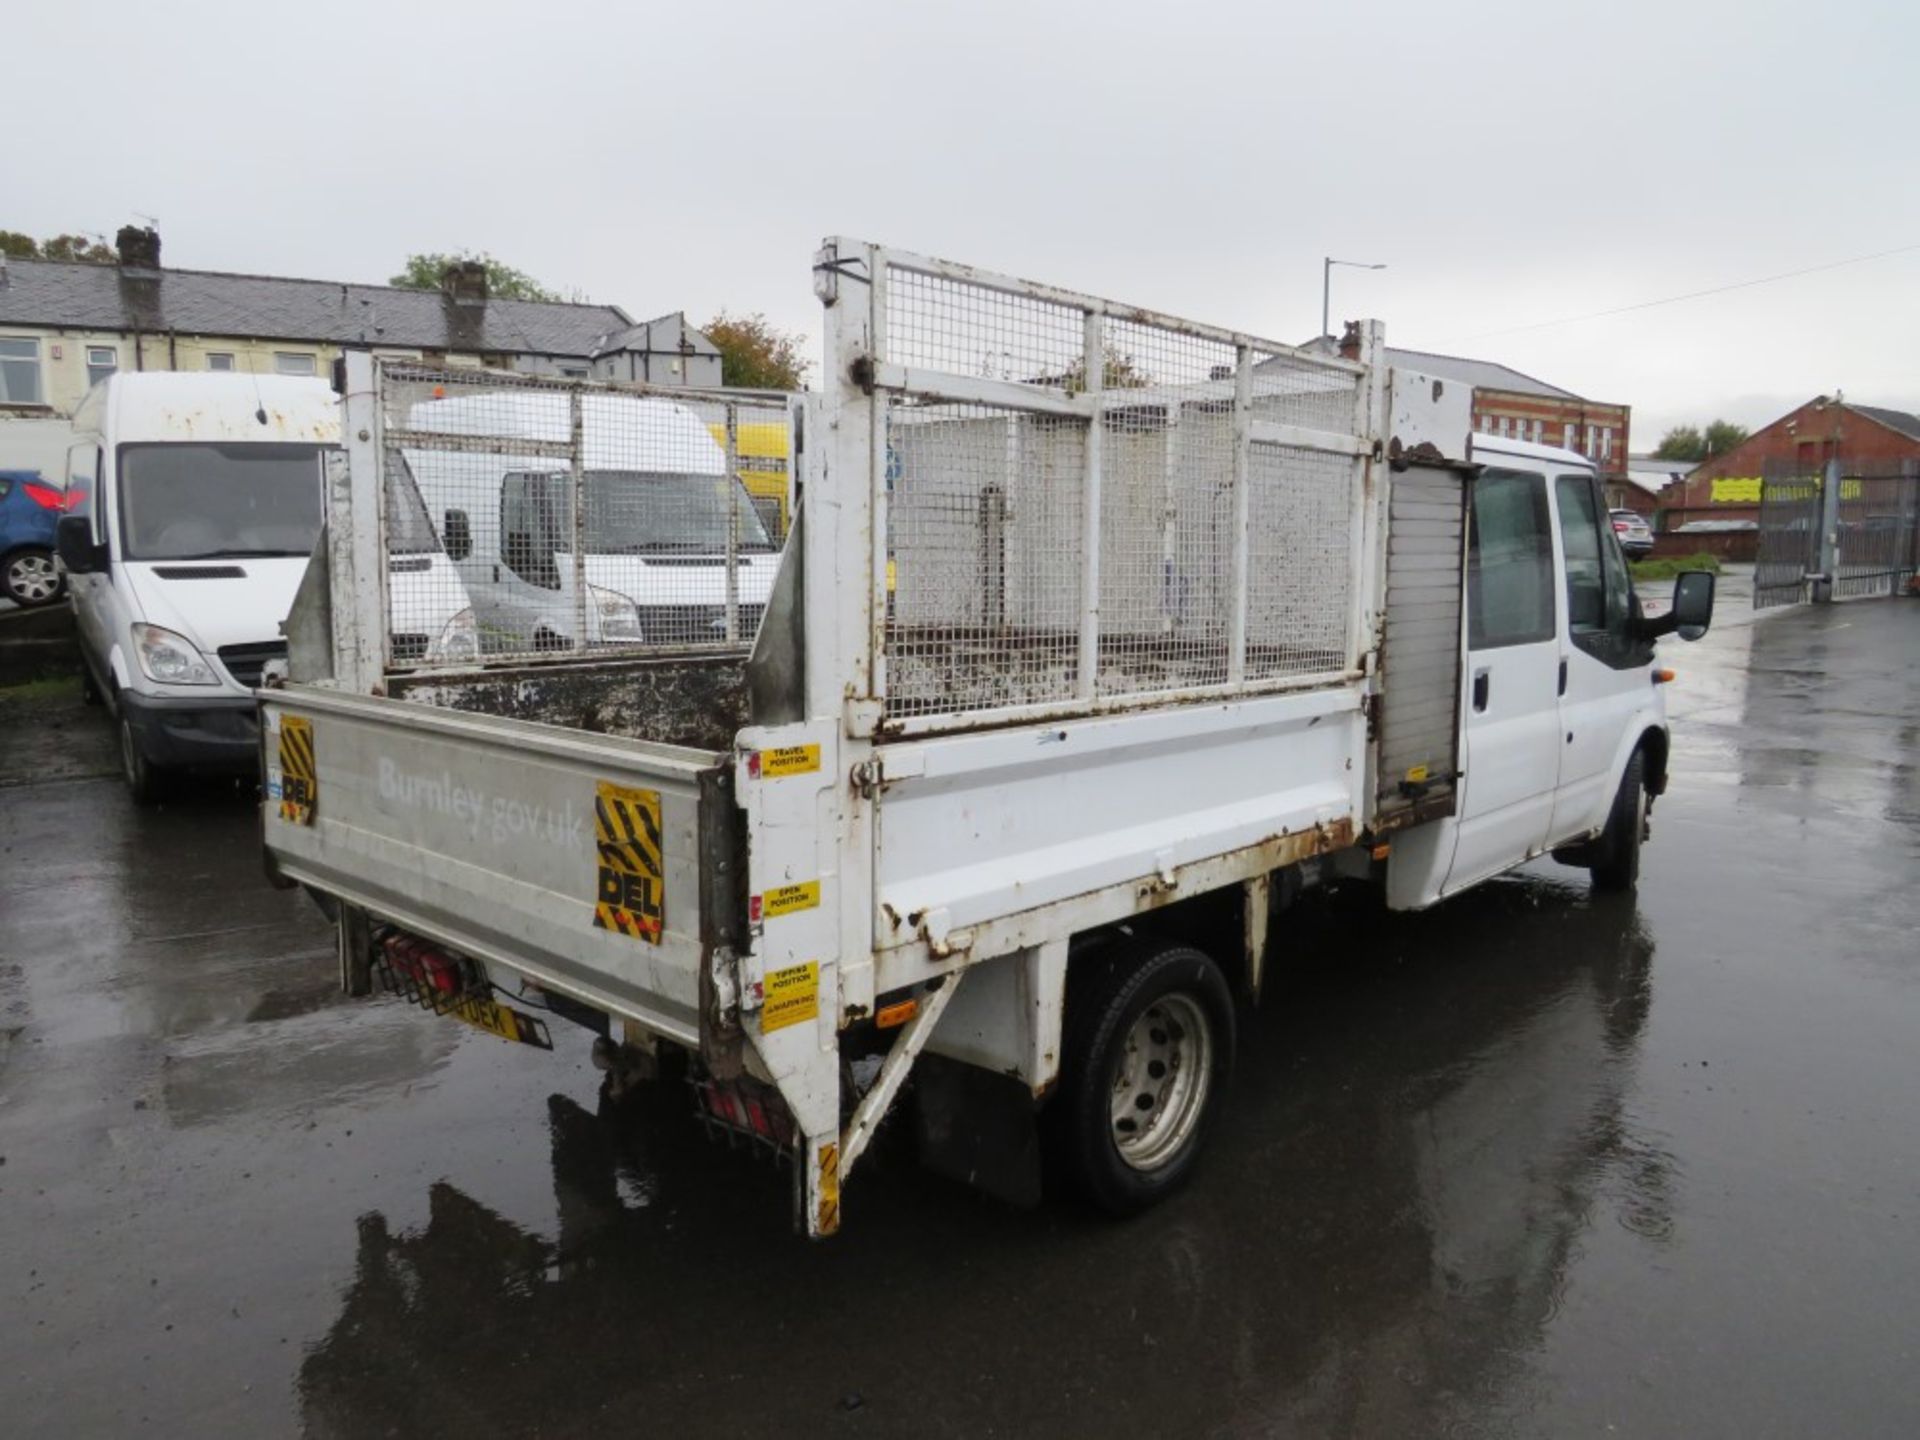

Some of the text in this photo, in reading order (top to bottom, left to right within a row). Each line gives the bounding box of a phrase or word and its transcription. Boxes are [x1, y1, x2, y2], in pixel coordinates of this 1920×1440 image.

[769, 755, 809, 768] POSITION
[281, 774, 315, 808] DEL
[598, 865, 661, 919] DEL
[770, 893, 809, 908] POSITION
[773, 973, 811, 989] POSITION
